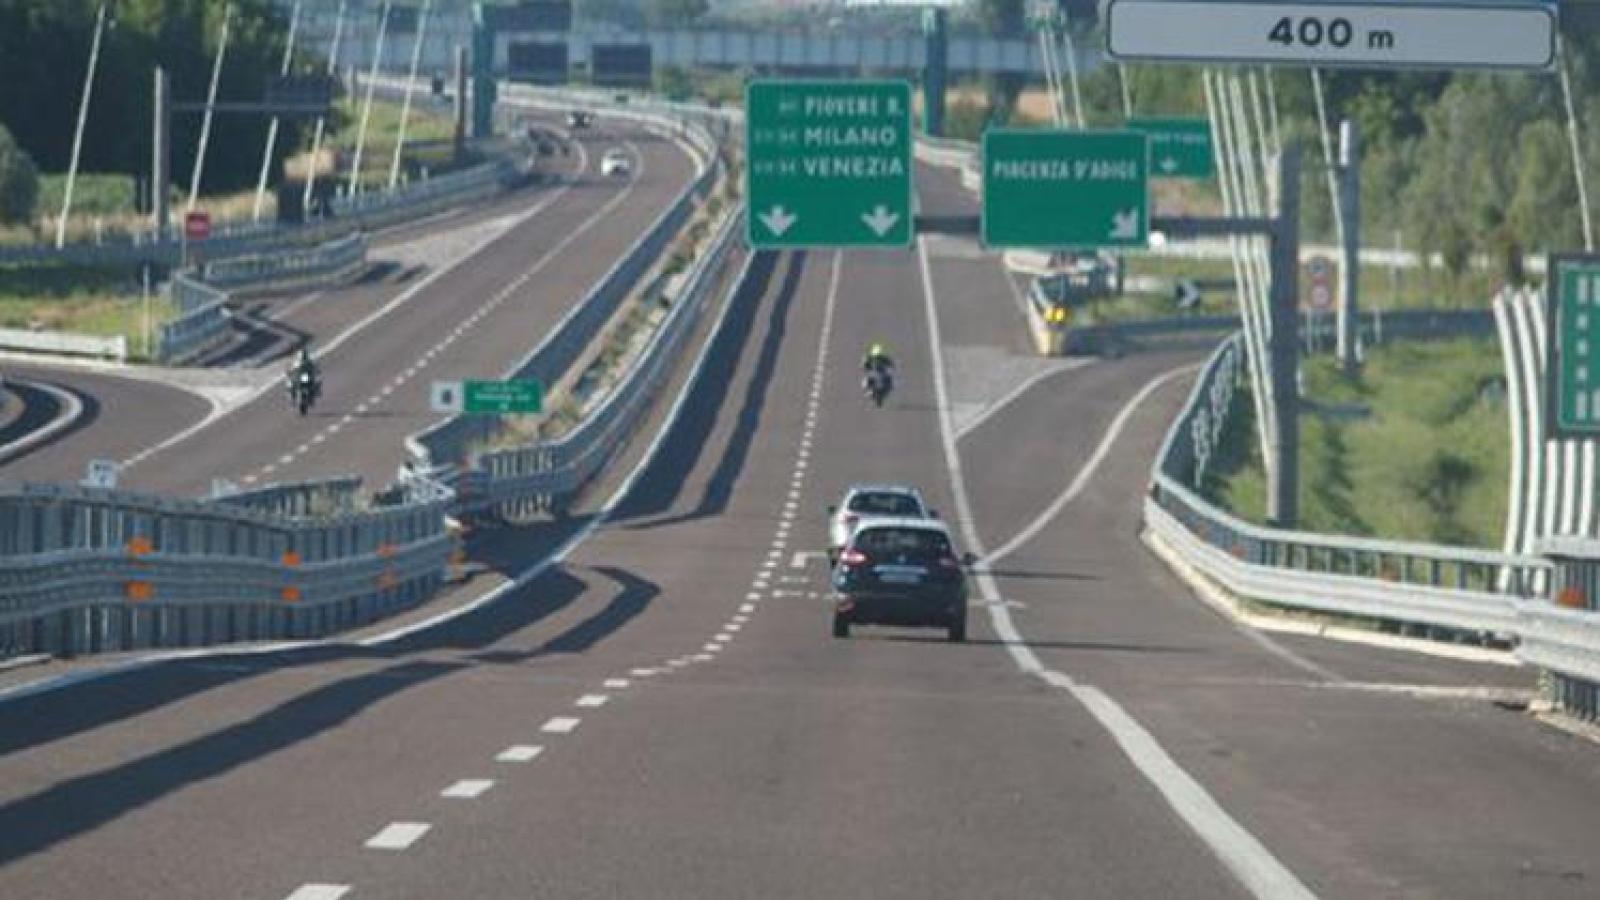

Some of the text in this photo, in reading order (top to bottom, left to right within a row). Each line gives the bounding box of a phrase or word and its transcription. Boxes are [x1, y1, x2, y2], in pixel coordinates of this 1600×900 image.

[1268, 17, 1395, 49] 400 m
[804, 127, 898, 146] MILANO
[803, 156, 904, 176] VENEZIA
